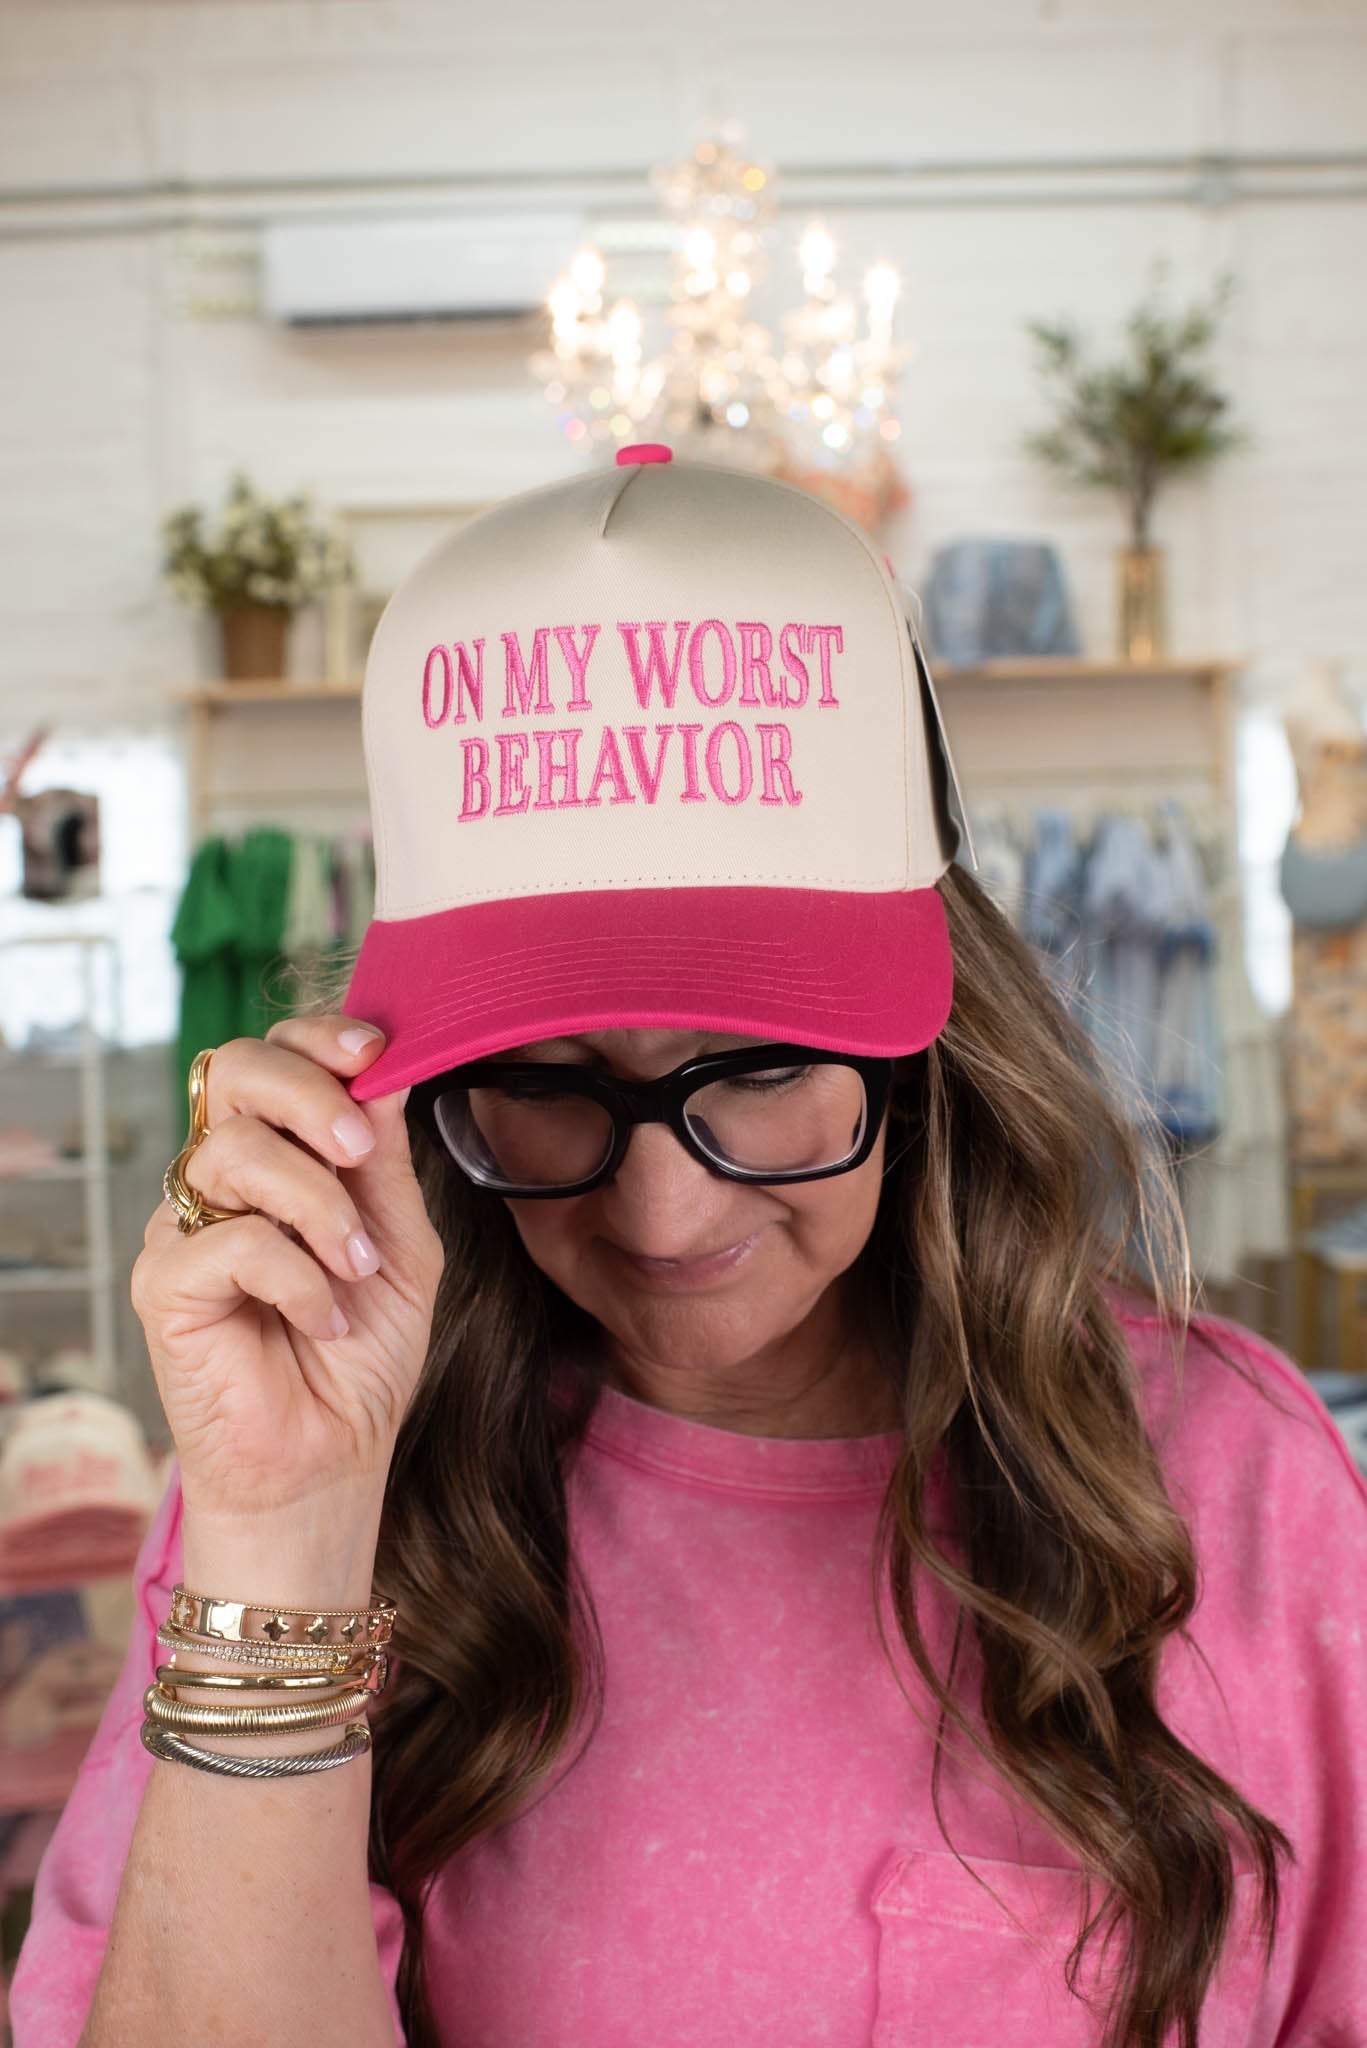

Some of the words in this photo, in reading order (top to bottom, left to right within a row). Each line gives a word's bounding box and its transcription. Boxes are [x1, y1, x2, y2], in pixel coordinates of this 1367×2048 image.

[422, 638, 486, 729] ON
[500, 624, 601, 717] MY
[616, 619, 844, 709] WORST
[457, 720, 803, 822] BEHAVIOR
